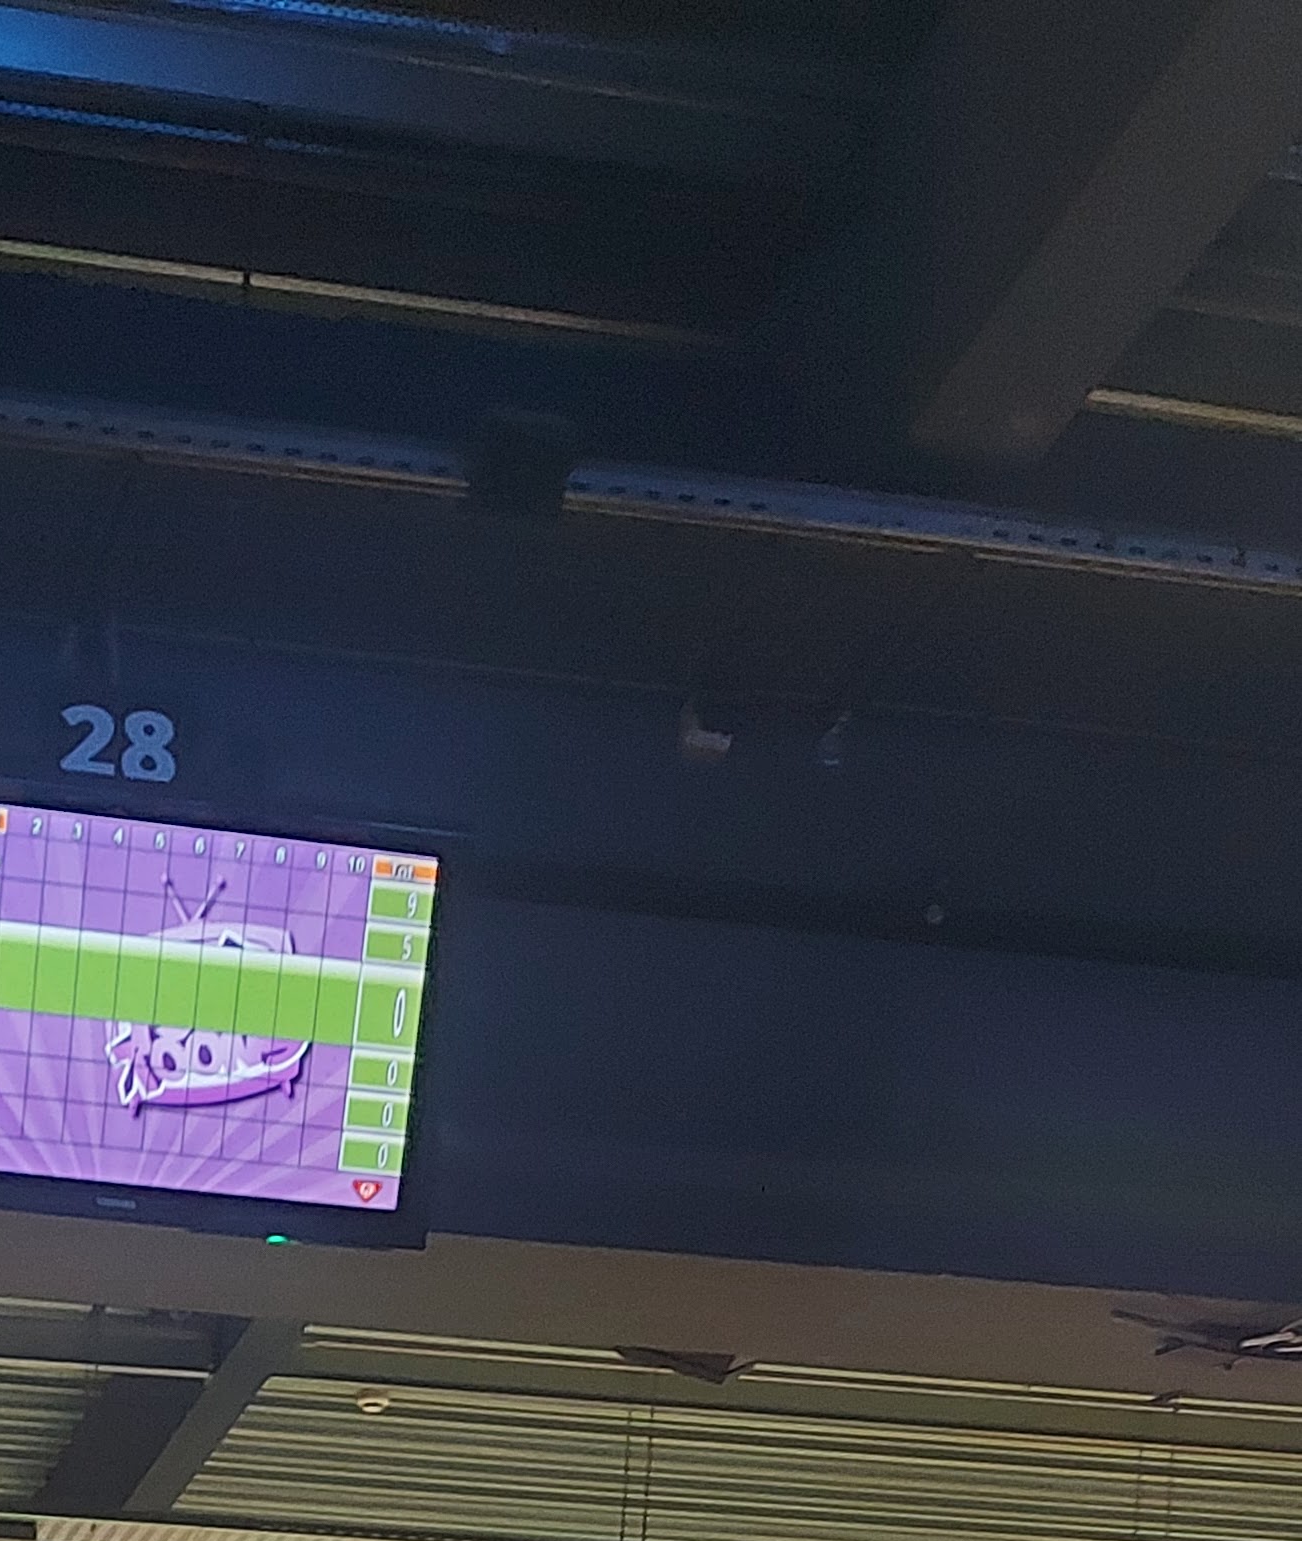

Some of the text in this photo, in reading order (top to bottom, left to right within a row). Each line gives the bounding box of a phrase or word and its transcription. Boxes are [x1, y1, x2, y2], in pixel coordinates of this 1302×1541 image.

[59, 703, 176, 783] 28
[31, 817, 42, 836] 2
[72, 821, 83, 841] 3
[113, 826, 123, 846] 4
[154, 831, 165, 850] 5
[194, 835, 205, 855] 6
[235, 840, 246, 859] 7
[275, 845, 287, 865] 8
[316, 850, 327, 870] 9
[347, 855, 366, 873] 10
[407, 890, 419, 918] 9
[401, 933, 412, 961] 5
[393, 987, 406, 1038] 0
[386, 1058, 398, 1086] 0
[381, 1101, 393, 1128] 0
[376, 1142, 389, 1169] 0
